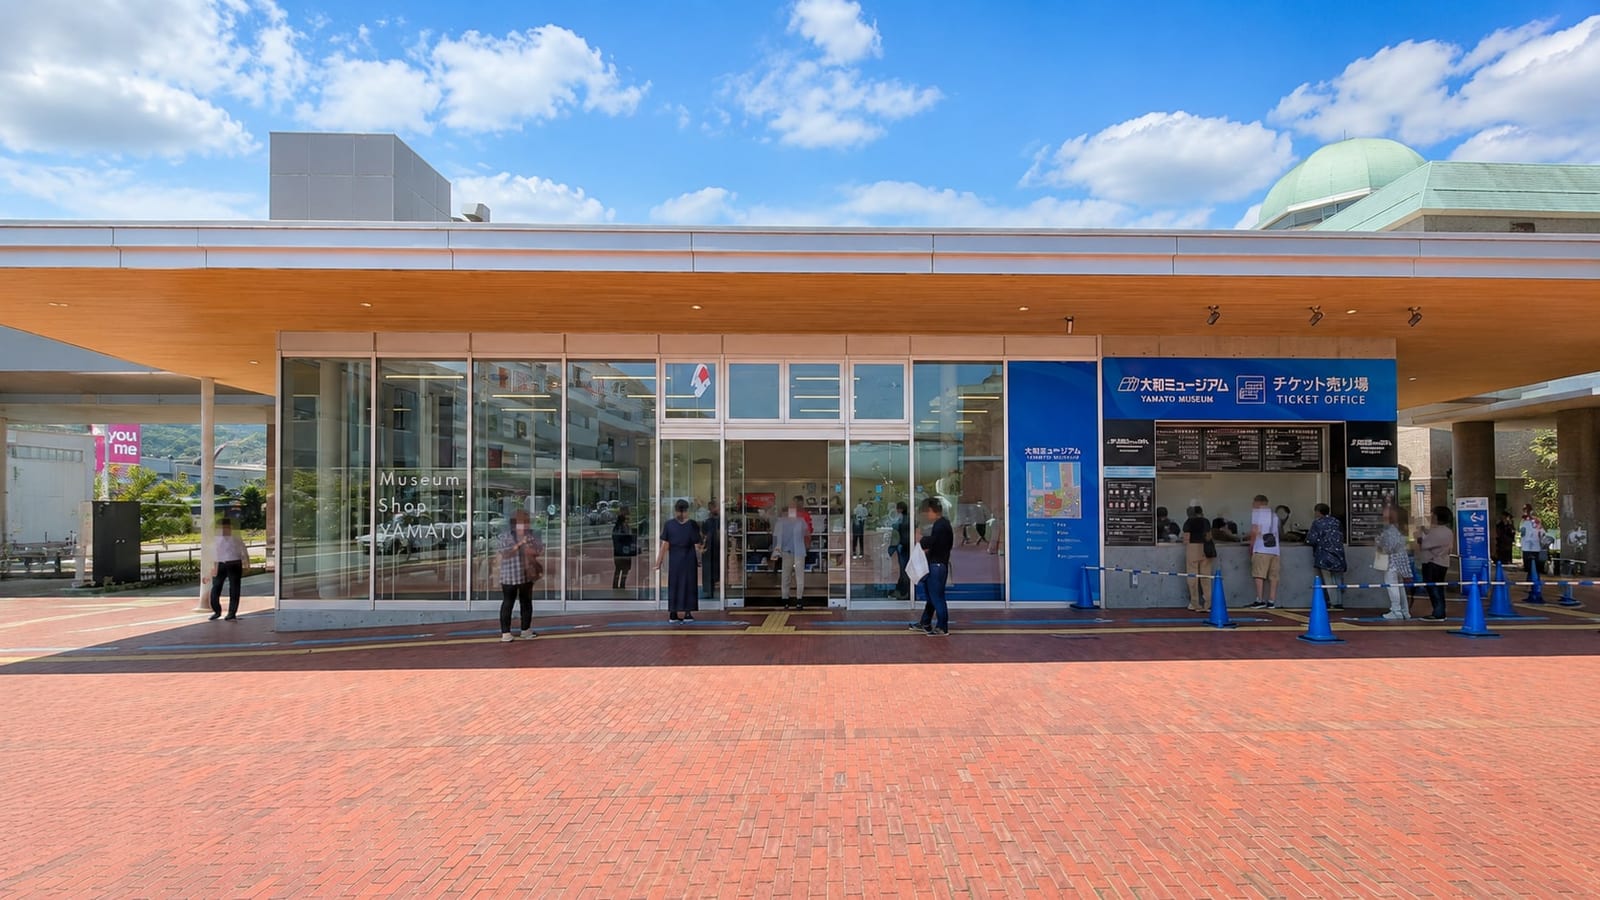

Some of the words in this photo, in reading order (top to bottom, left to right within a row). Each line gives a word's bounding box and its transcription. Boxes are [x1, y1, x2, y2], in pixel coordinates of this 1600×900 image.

[1140, 377, 1229, 391] 大和ミュージアム
[1273, 376, 1369, 392] チケット売り場
[1141, 395, 1176, 403] YAMATO
[1178, 395, 1214, 403] MUSEUM
[1276, 394, 1319, 404] TICKET
[1324, 394, 1365, 404] OFFICE
[108, 430, 137, 443] you
[114, 443, 137, 455] me
[379, 471, 459, 486] Museum
[378, 496, 426, 517] Shop
[380, 523, 465, 538] YAMATO
